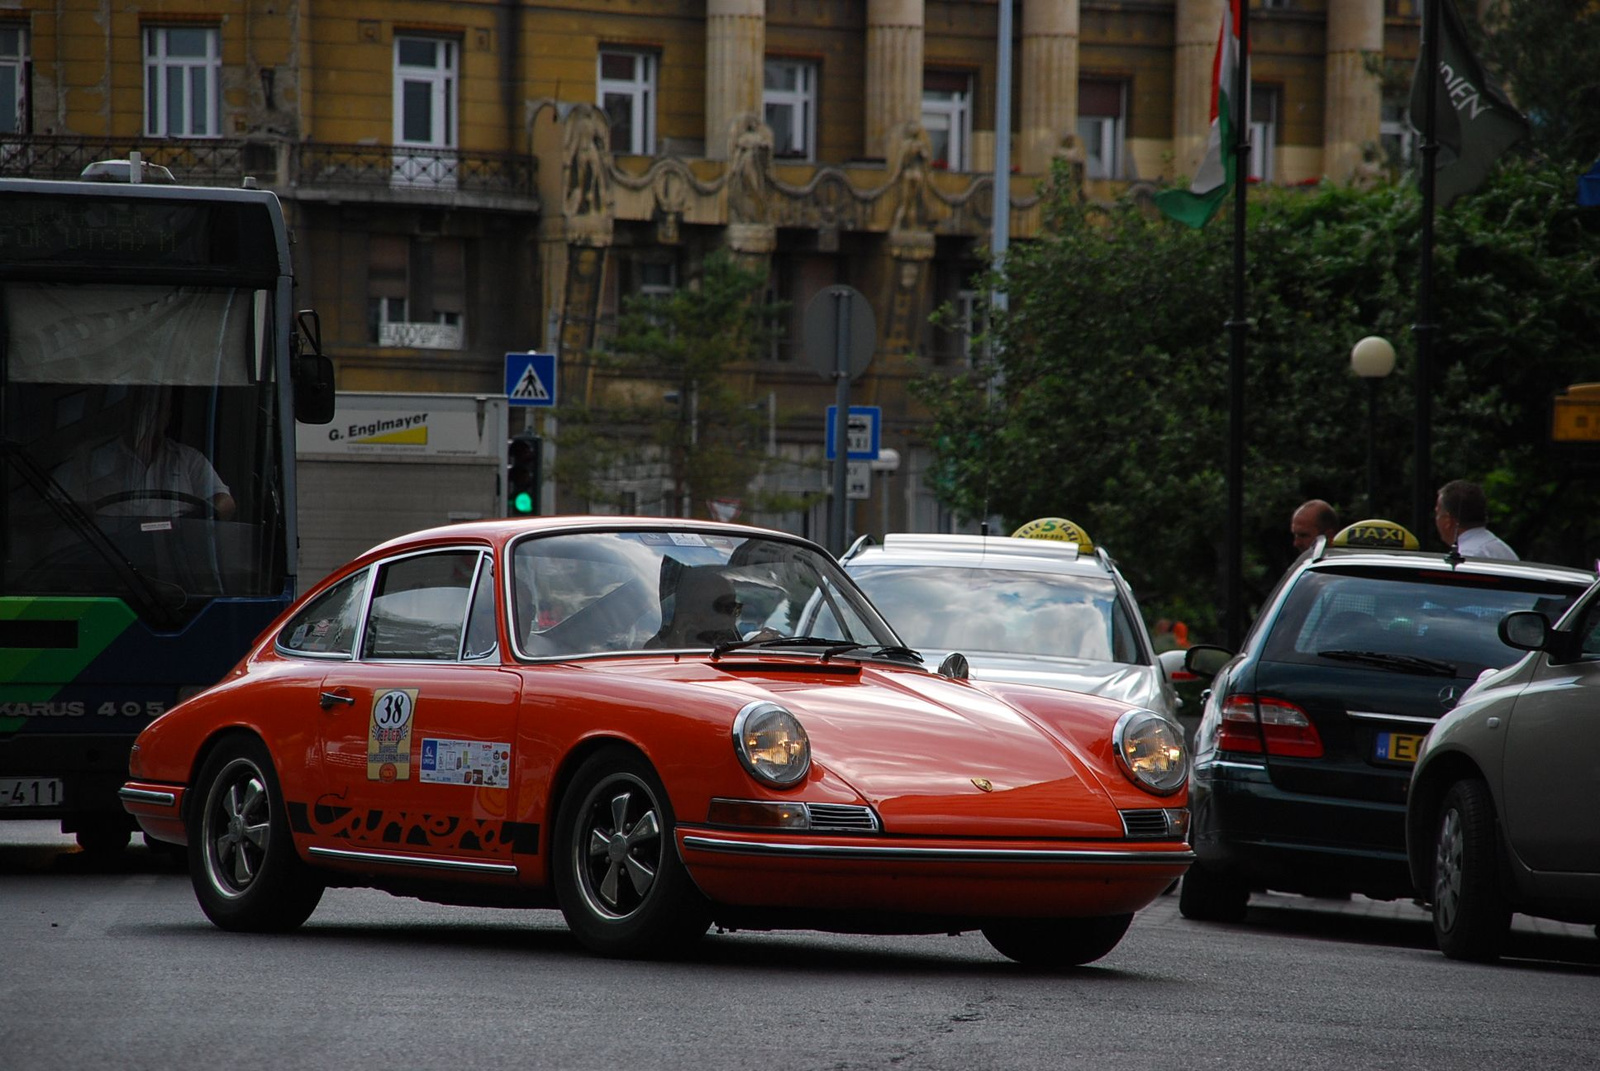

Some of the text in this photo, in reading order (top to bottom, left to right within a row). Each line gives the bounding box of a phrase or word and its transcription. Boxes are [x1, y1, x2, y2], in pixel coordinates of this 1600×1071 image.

[1440, 61, 1492, 119] DIEN
[328, 413, 428, 441] G. Englmayer
[1041, 520, 1058, 532] 5
[1059, 523, 1078, 541] TAXI
[1351, 527, 1403, 540] TAXI
[97, 701, 164, 717] 405
[380, 695, 404, 723] 38
[306, 788, 516, 853] Carrera
